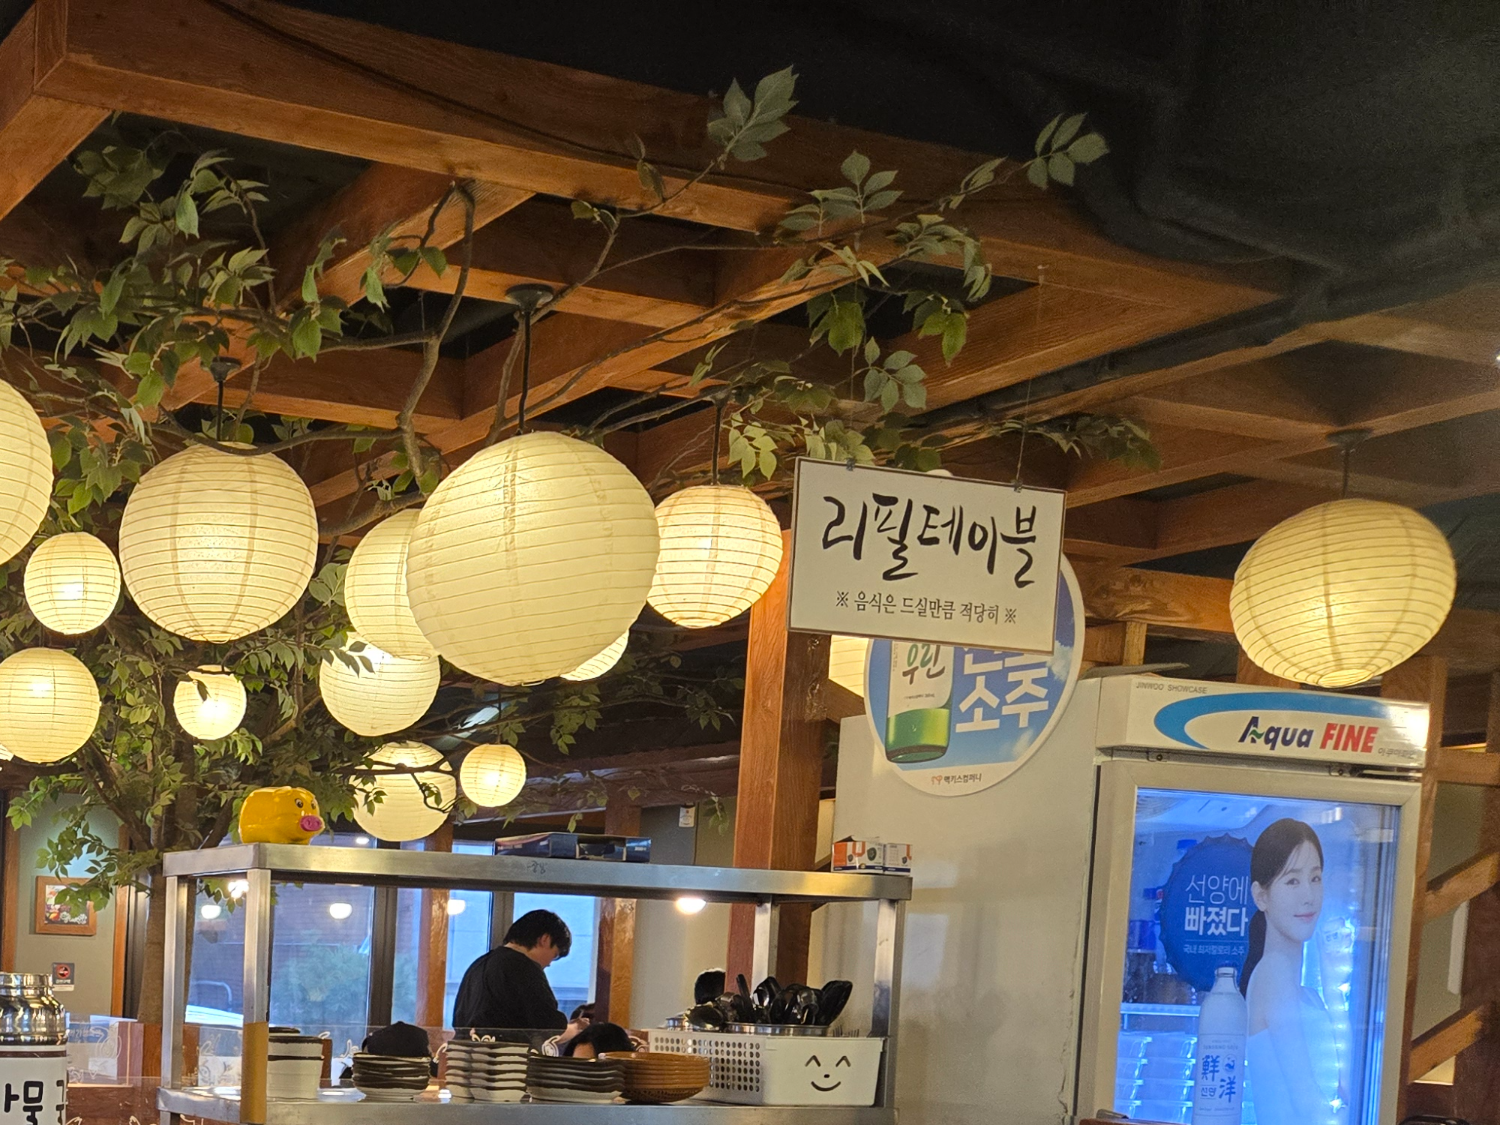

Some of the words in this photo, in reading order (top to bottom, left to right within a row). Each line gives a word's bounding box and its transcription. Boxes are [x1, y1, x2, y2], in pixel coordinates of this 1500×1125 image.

[822, 493, 1037, 588] 리필테이블
[854, 591, 896, 614] 음식은
[901, 597, 956, 620] 드실만큼
[960, 602, 999, 625] 적당히
[956, 667, 1049, 733] 소주
[1167, 684, 1207, 694] SHOWCASE
[1238, 716, 1315, 750] Aqua
[1320, 722, 1379, 753] FINE
[1185, 874, 1249, 905] 선양에
[1184, 905, 1249, 937] 빠졌다
